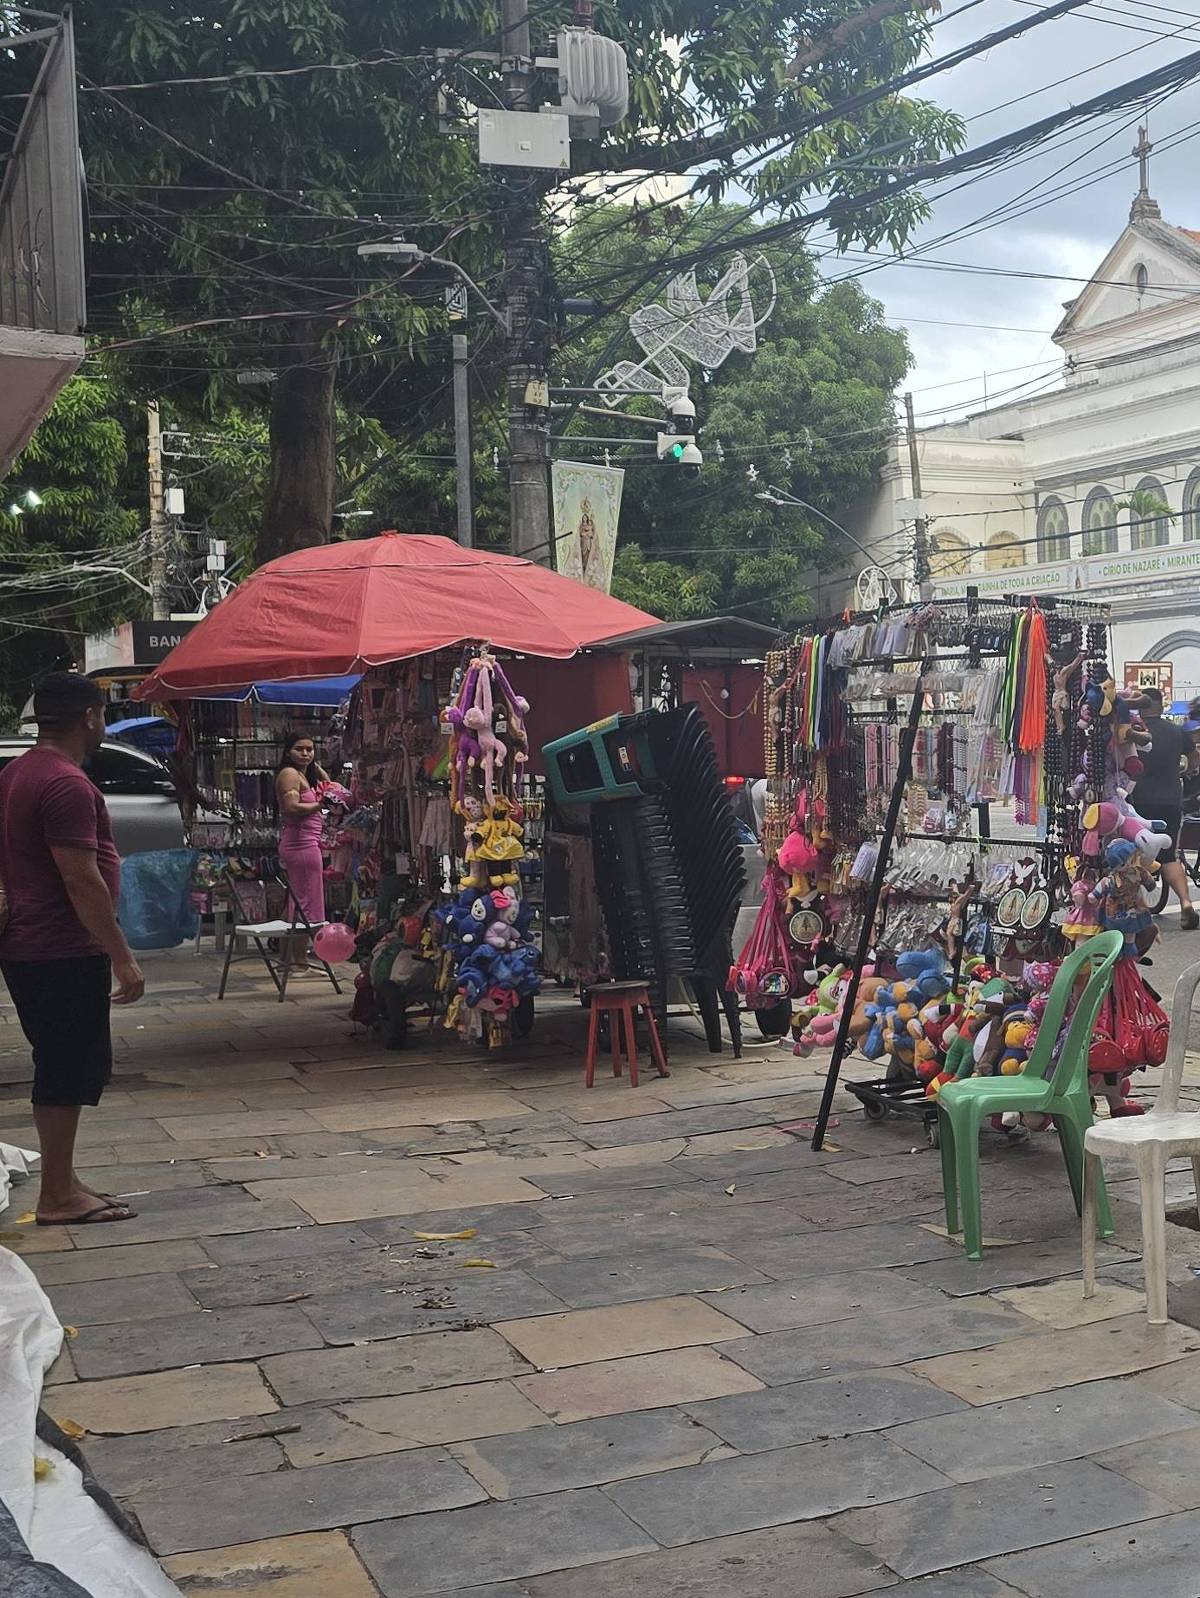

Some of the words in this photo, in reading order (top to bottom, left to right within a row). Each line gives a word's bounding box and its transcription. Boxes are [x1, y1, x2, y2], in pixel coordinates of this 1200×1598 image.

[1122, 563, 1132, 574] DE
[1132, 558, 1162, 573] NAZARÉ
[1167, 554, 1200, 568] MIRANTE
[1000, 578, 1008, 590] DE
[1008, 576, 1025, 588] TODA
[1025, 576, 1031, 585] A
[1031, 571, 1060, 587] CRIAÇÃO
[149, 635, 183, 648] BAN
